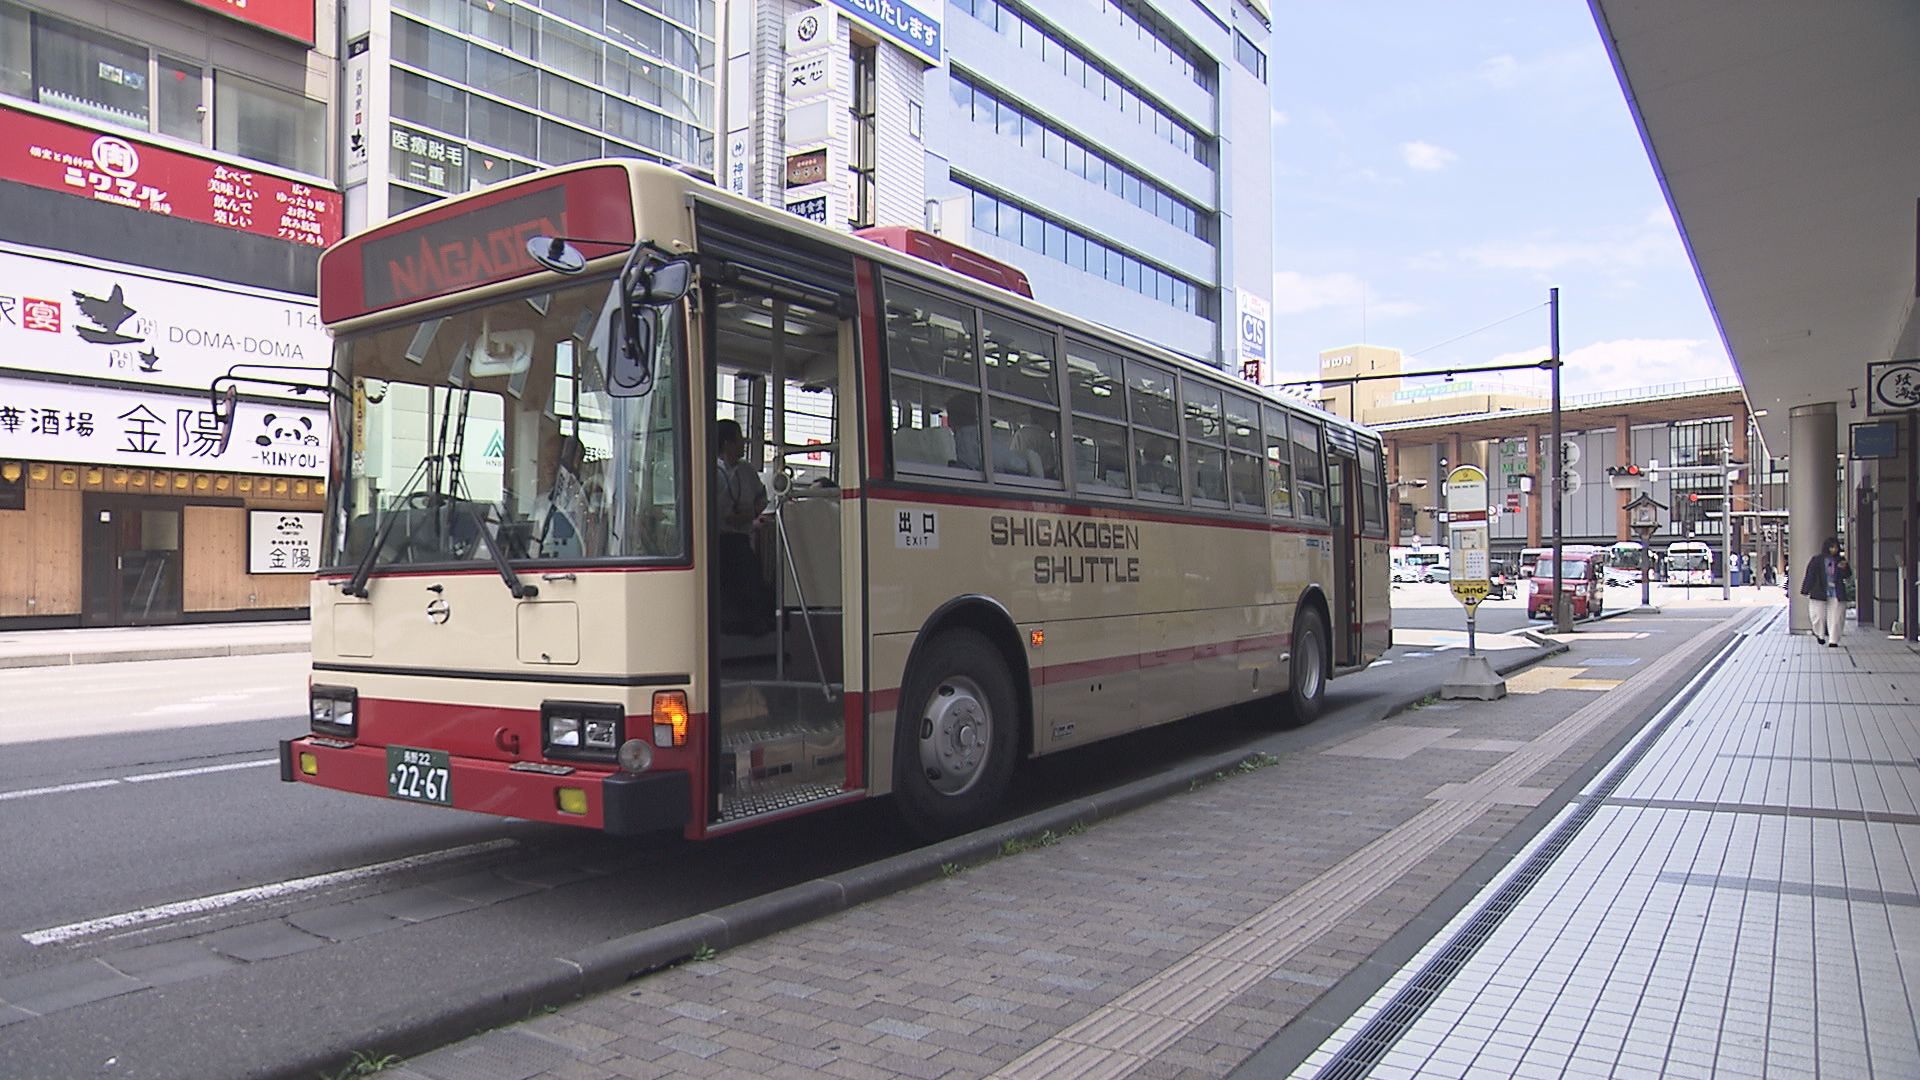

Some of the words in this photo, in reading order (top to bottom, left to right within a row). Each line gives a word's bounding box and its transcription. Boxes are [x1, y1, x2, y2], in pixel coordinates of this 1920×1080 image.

[393, 129, 463, 167] 医療脱毛
[409, 161, 446, 186] 二重
[169, 326, 304, 359] DOMA-DOMA
[899, 511, 935, 533] 出口
[990, 515, 1139, 550] SHIGAKOGEN
[906, 536, 929, 546] EXIT
[1034, 555, 1139, 584] SHUTTLE
